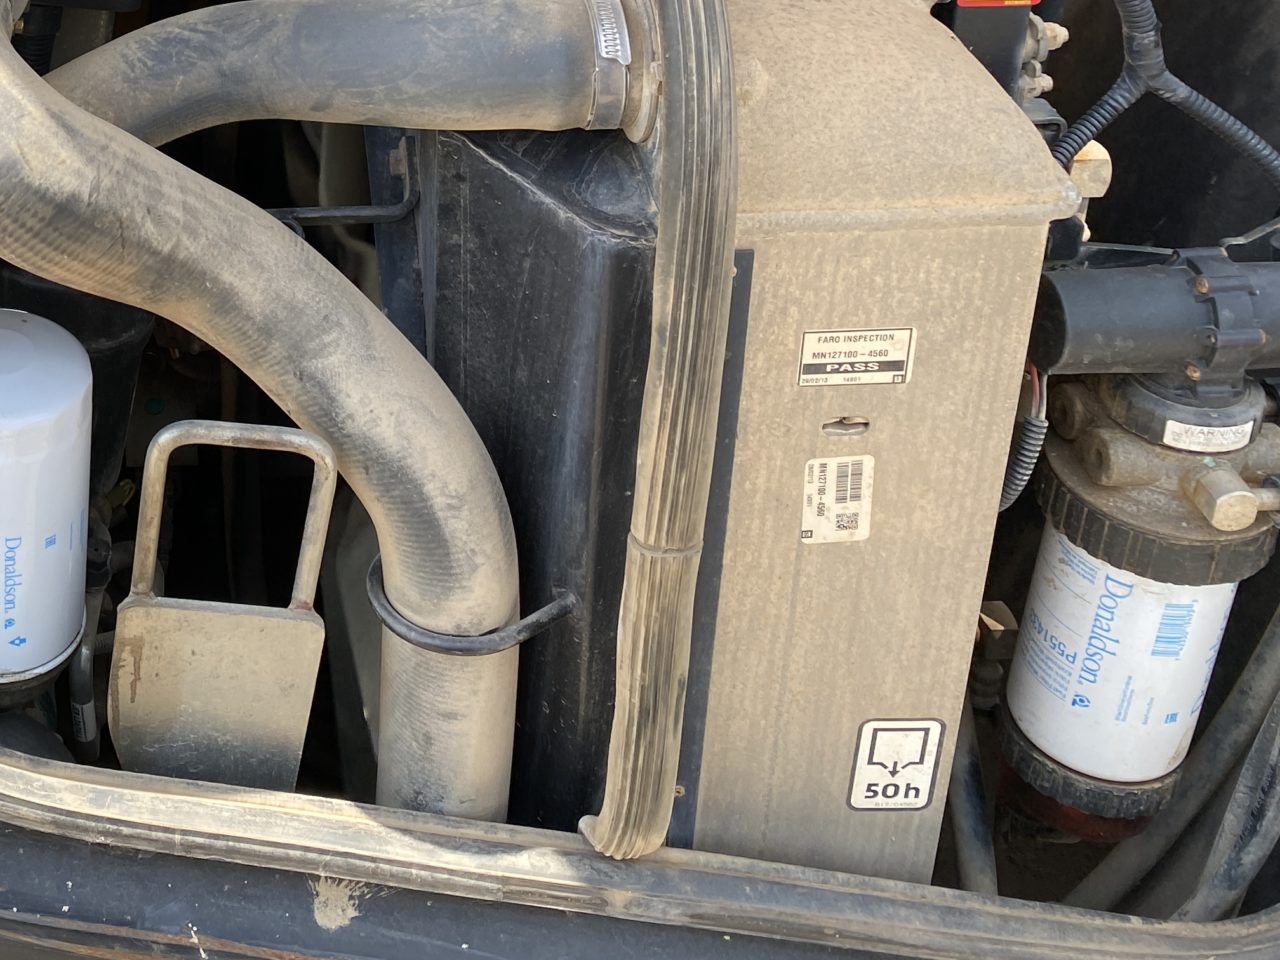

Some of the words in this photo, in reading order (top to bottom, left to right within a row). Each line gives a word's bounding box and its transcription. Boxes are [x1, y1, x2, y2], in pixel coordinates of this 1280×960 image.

[817, 335, 841, 344] FARO
[843, 333, 895, 343] INSPECTION
[825, 362, 880, 372] PASS
